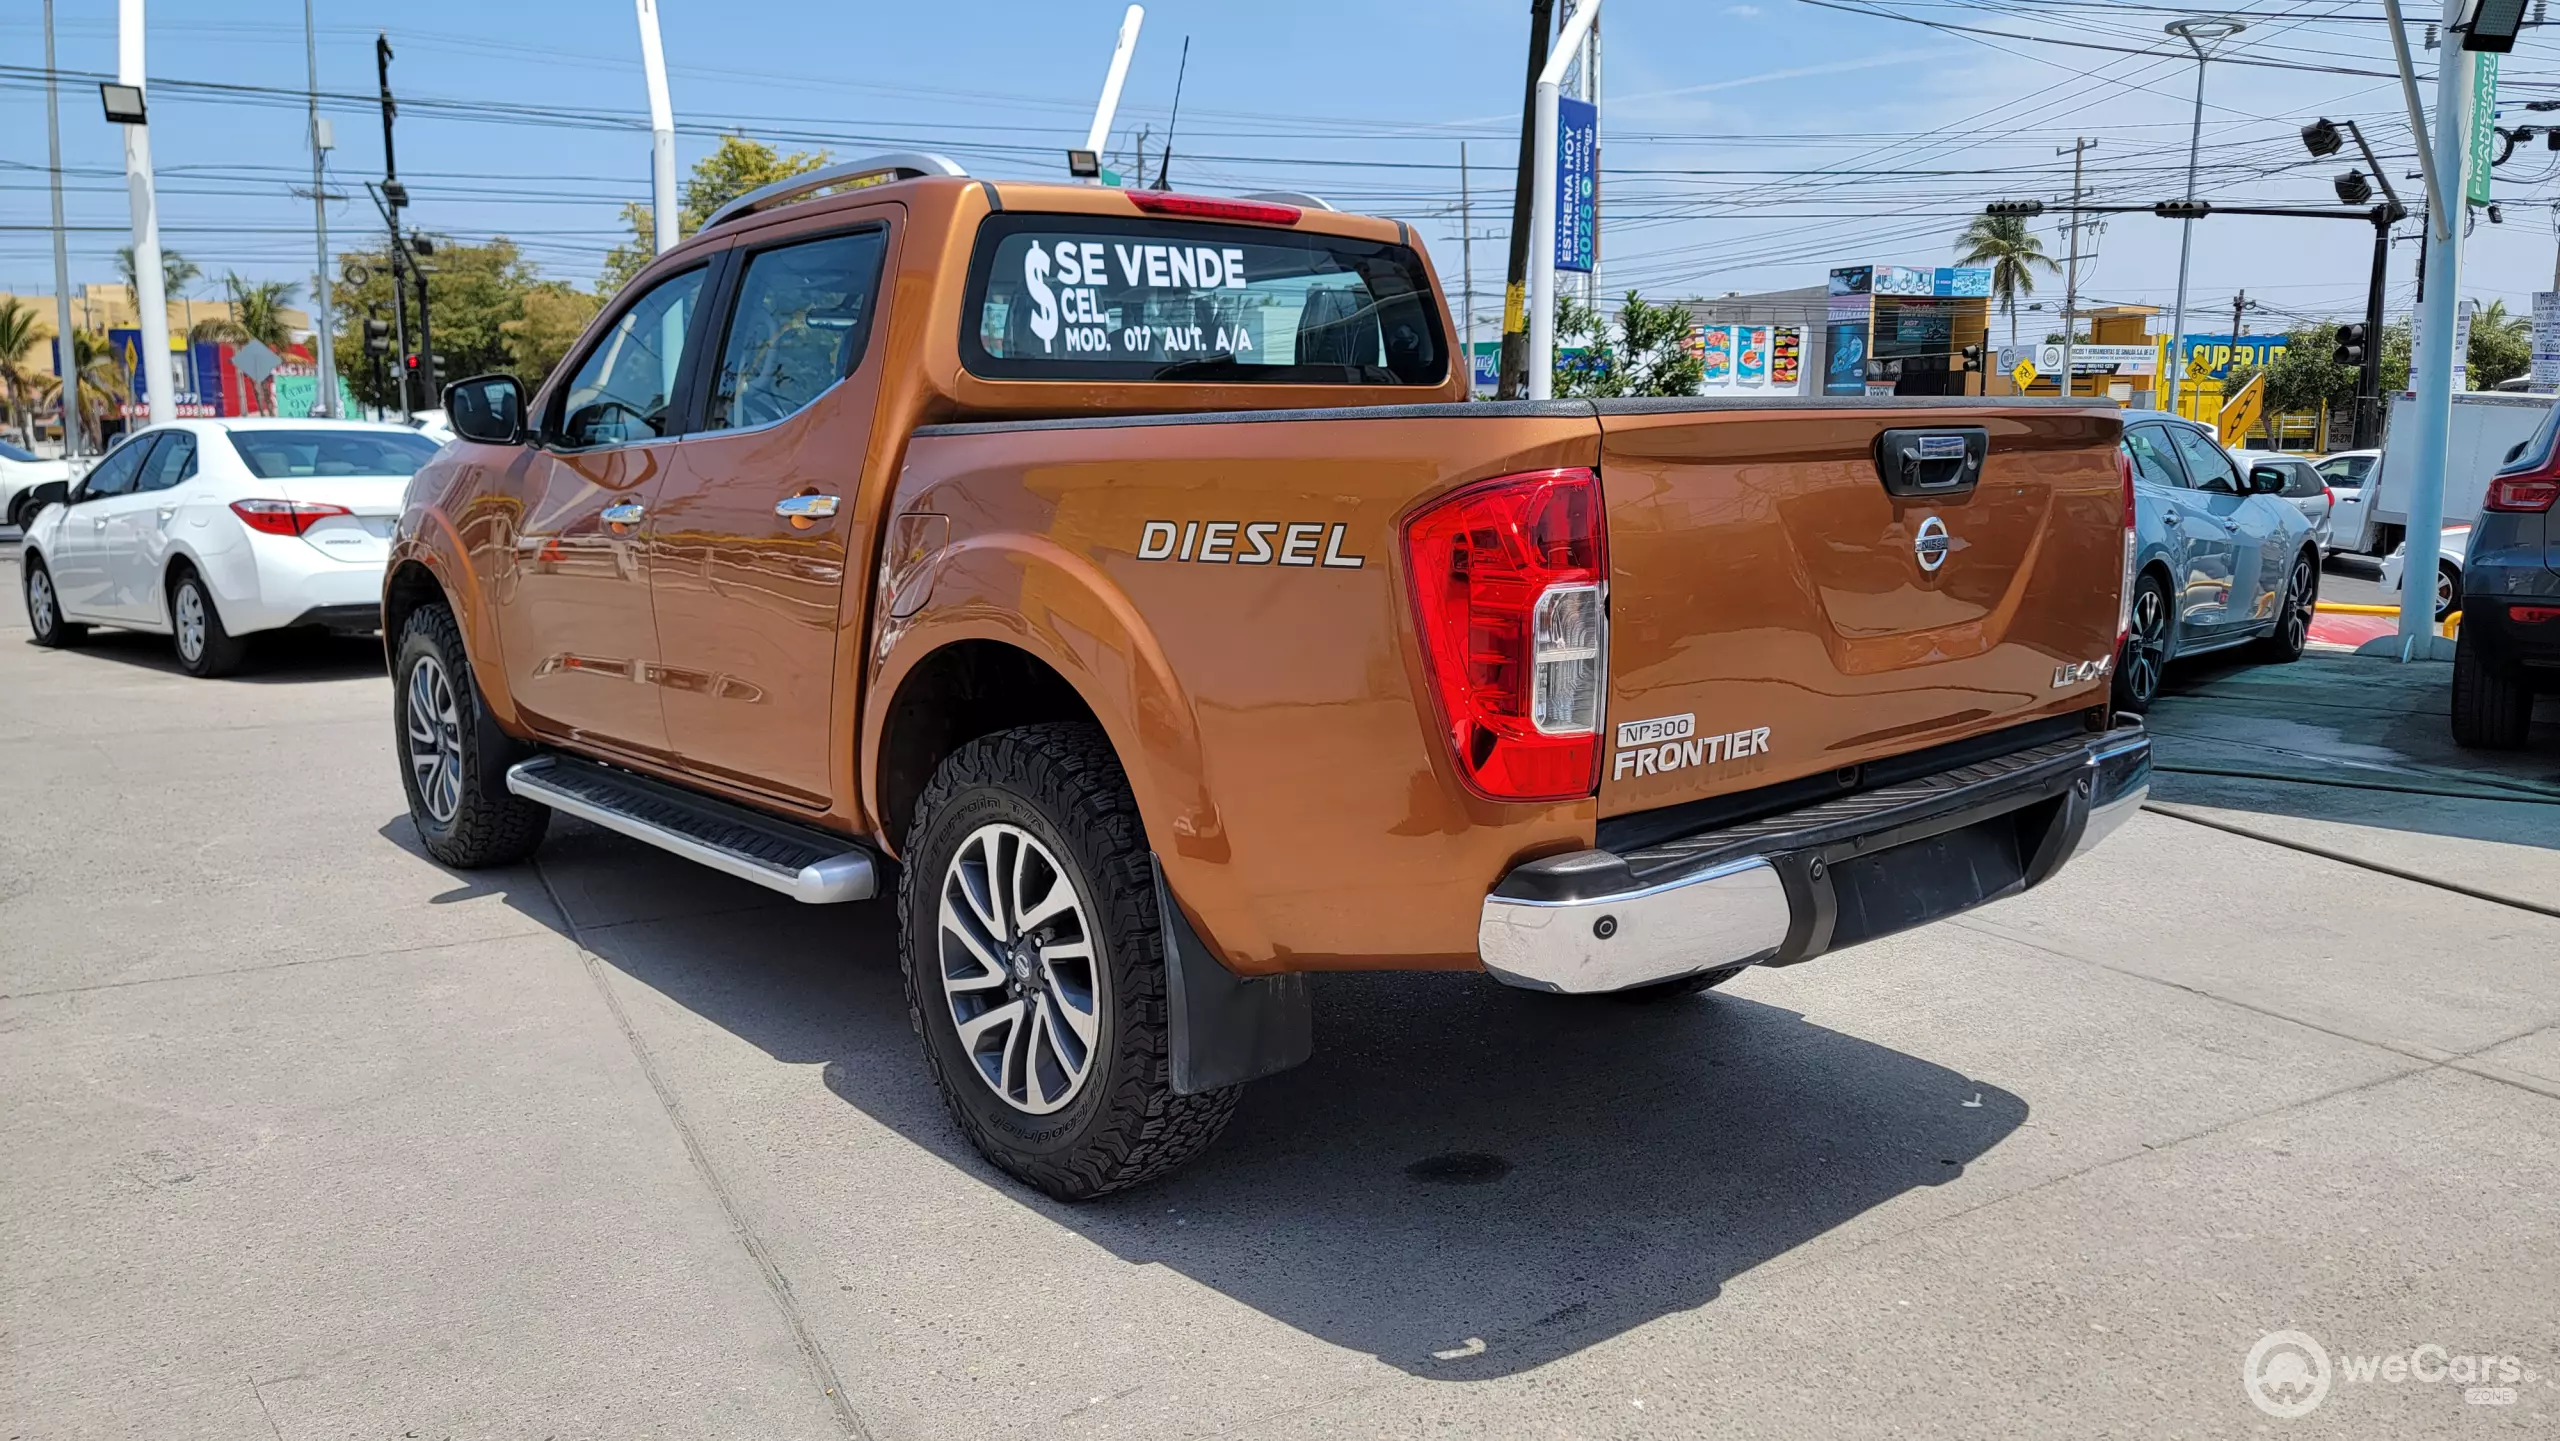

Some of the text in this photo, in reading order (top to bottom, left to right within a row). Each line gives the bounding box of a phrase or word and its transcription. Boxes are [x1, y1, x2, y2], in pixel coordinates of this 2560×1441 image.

[1562, 126, 1575, 262] ESTRENA HOY
[1579, 204, 1592, 269] 2025
[1054, 241, 1247, 289] SE VENDE
[1064, 328, 1112, 352] MOD.
[1215, 324, 1254, 355] A/A
[1136, 520, 1366, 569] DIESEL
[1613, 726, 1771, 782] FRONTIER
[1625, 719, 1689, 743] NP300
